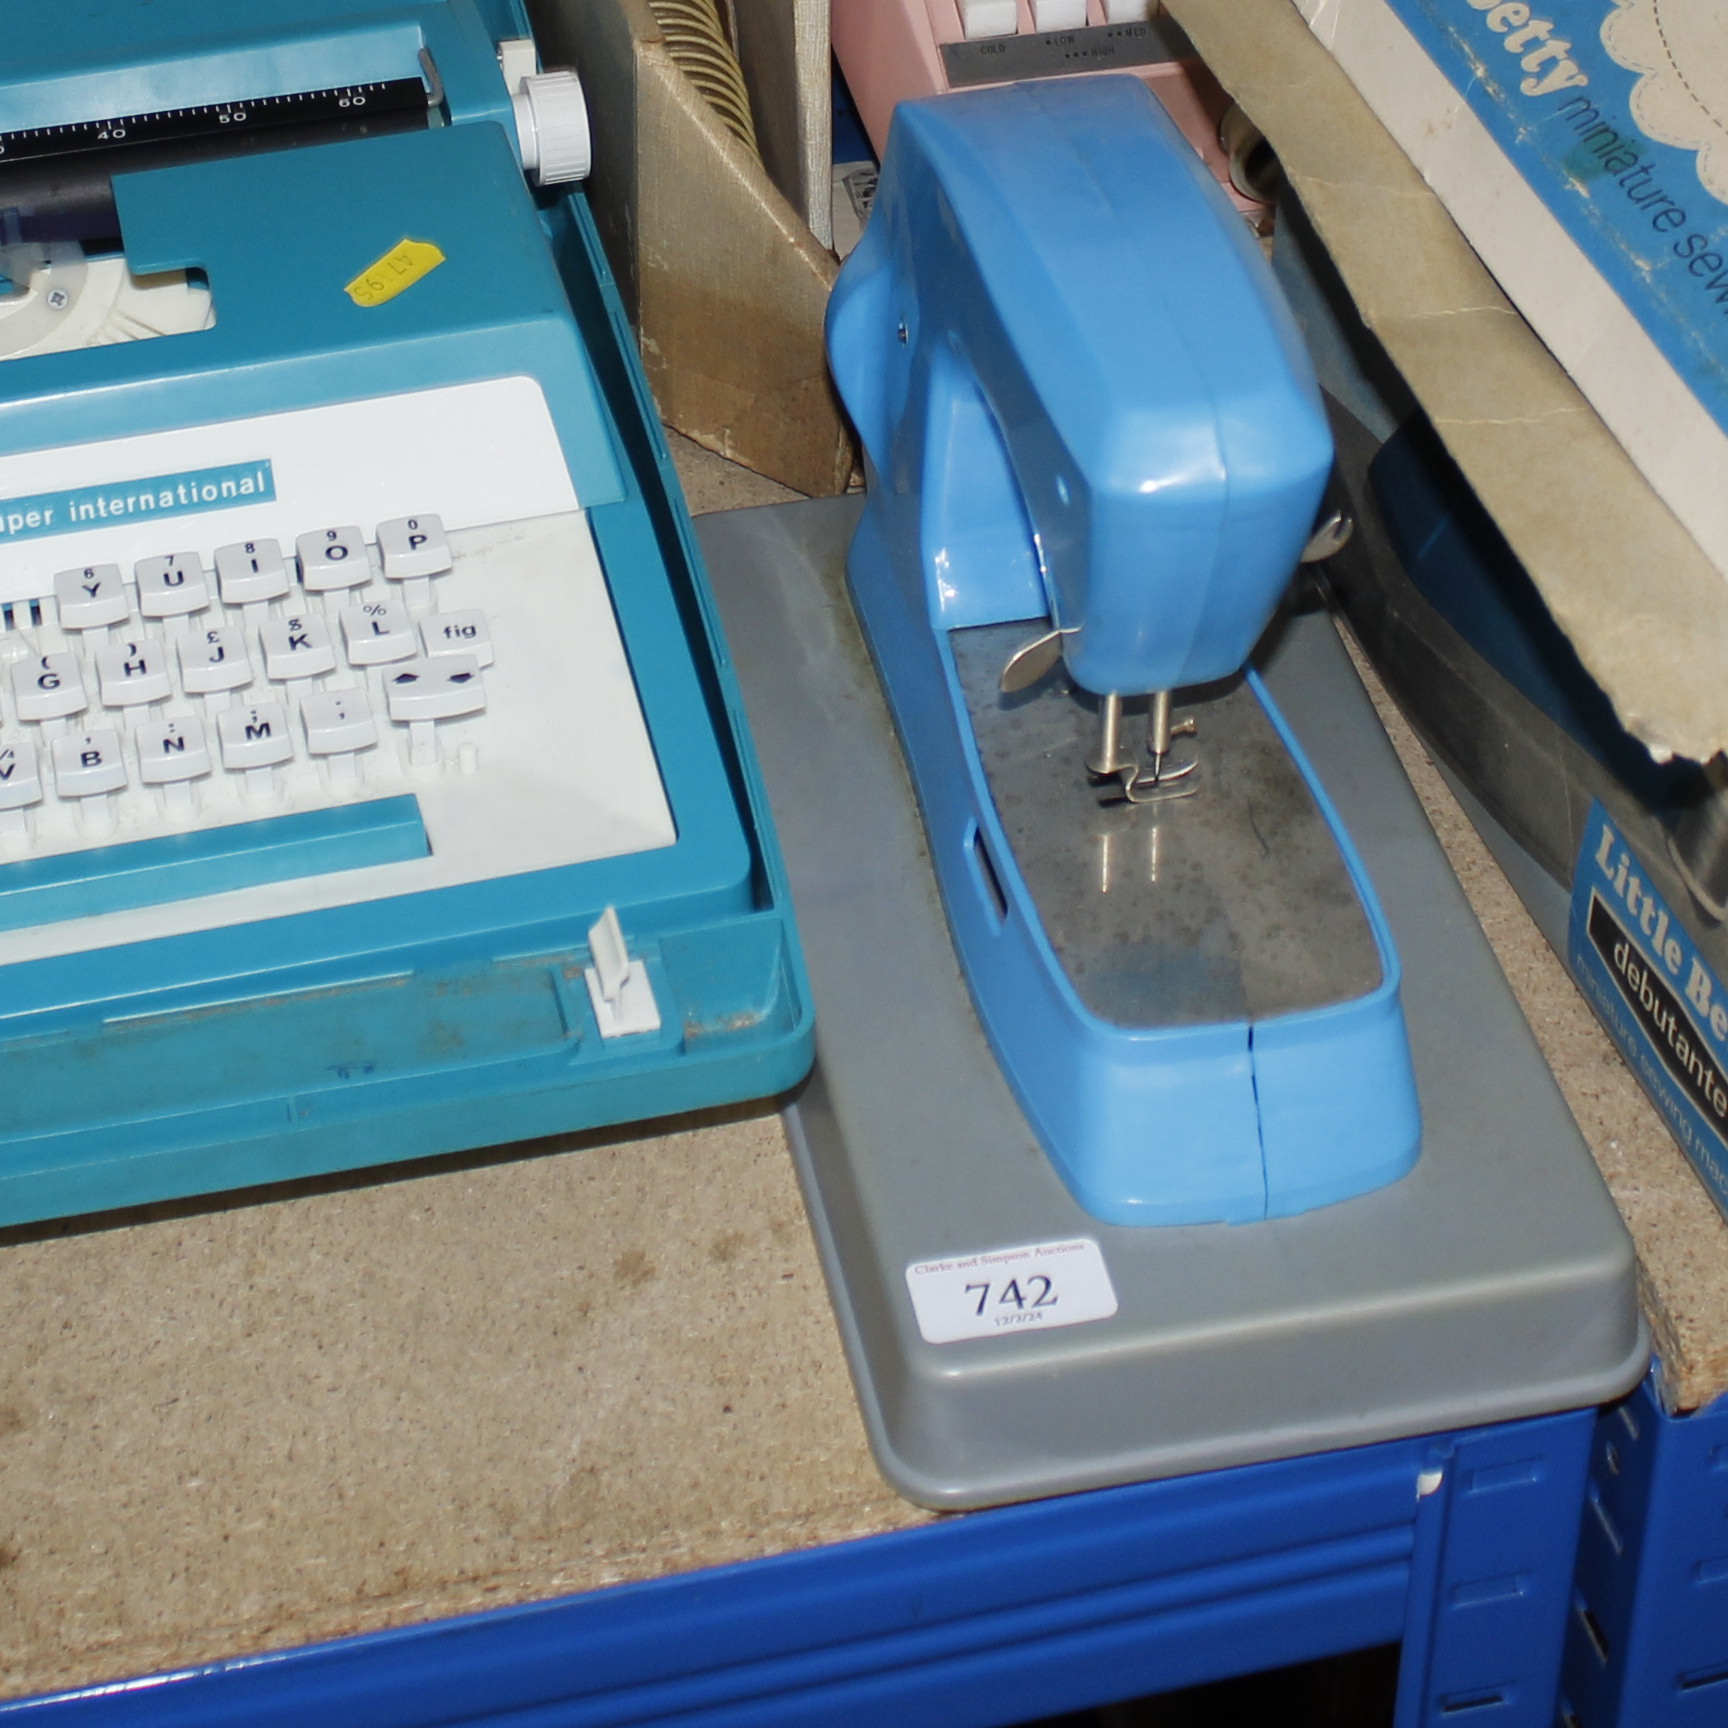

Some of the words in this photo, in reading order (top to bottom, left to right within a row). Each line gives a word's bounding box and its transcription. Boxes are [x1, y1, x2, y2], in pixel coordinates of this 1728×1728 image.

[1125, 28, 1146, 36] MED
[980, 44, 1006, 54] COLD
[1091, 47, 1115, 58] HIGH
[338, 96, 366, 107] 60
[219, 111, 247, 124] 50
[97, 128, 126, 140] 40
[1558, 94, 1686, 232] miniature
[69, 470, 266, 522] international
[327, 531, 337, 541] 9
[409, 535, 427, 550] P
[245, 543, 255, 554] 8
[326, 546, 348, 560] O
[164, 556, 174, 566] 7
[251, 559, 258, 572] I
[84, 569, 94, 578] 6
[164, 571, 184, 586] U
[82, 582, 100, 598] Y
[363, 604, 387, 616] %
[372, 621, 389, 635] L
[443, 626, 476, 639] fig
[207, 631, 220, 644] £
[289, 634, 312, 650] K
[209, 647, 224, 663] J
[124, 659, 146, 676] H
[38, 674, 60, 690] G
[245, 723, 271, 740] M
[164, 736, 184, 753] N
[81, 751, 102, 768] B
[1594, 824, 1683, 975] Little
[1614, 941, 1728, 1117] debutante
[1577, 954, 1637, 1057] miniature
[1641, 1053, 1693, 1146] sewing
[914, 1264, 953, 1275] Clarke
[957, 1259, 977, 1269] and
[981, 1251, 1030, 1265] Simpson
[1034, 1243, 1085, 1258] Auctions
[965, 1275, 1058, 1316] 742
